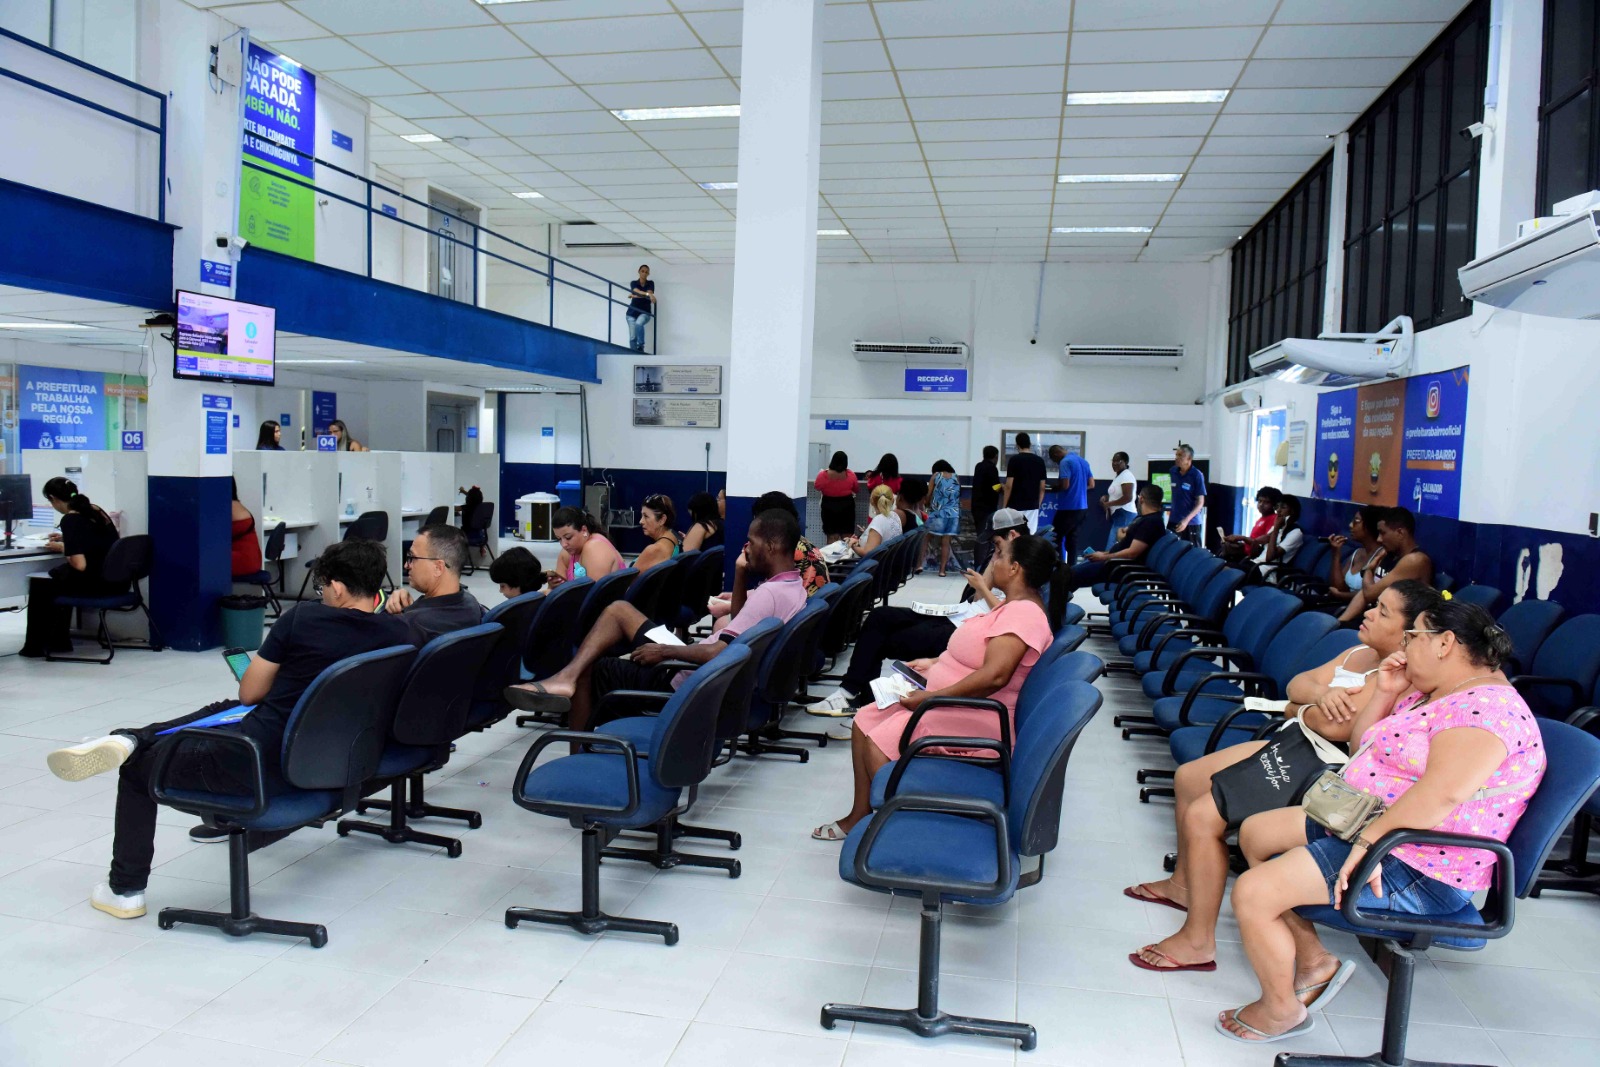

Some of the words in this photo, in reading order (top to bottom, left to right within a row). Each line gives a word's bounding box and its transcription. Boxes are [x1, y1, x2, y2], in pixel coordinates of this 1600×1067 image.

[246, 55, 269, 78] NÃO
[272, 67, 302, 95] PODE
[276, 108, 301, 131] NÃO.
[257, 121, 267, 137] NO
[268, 128, 296, 149] COMBATE
[250, 136, 255, 148] E
[255, 138, 300, 166] CHIKUNGUNYA.
[917, 375, 954, 384] RECEPÇÃO
[26, 381, 34, 390] A
[36, 381, 97, 394] PREFEITURA
[35, 392, 90, 404] TRABALHA
[31, 403, 57, 413] PELA
[60, 404, 93, 415] NOSSA
[43, 413, 83, 425] REGIÃO.
[55, 435, 88, 444] SALVADOR
[124, 433, 141, 445] 06
[320, 437, 335, 447] 04
[1406, 449, 1457, 461] PREFEITURA-BAIRRO
[1422, 482, 1443, 494] SALVADOR
